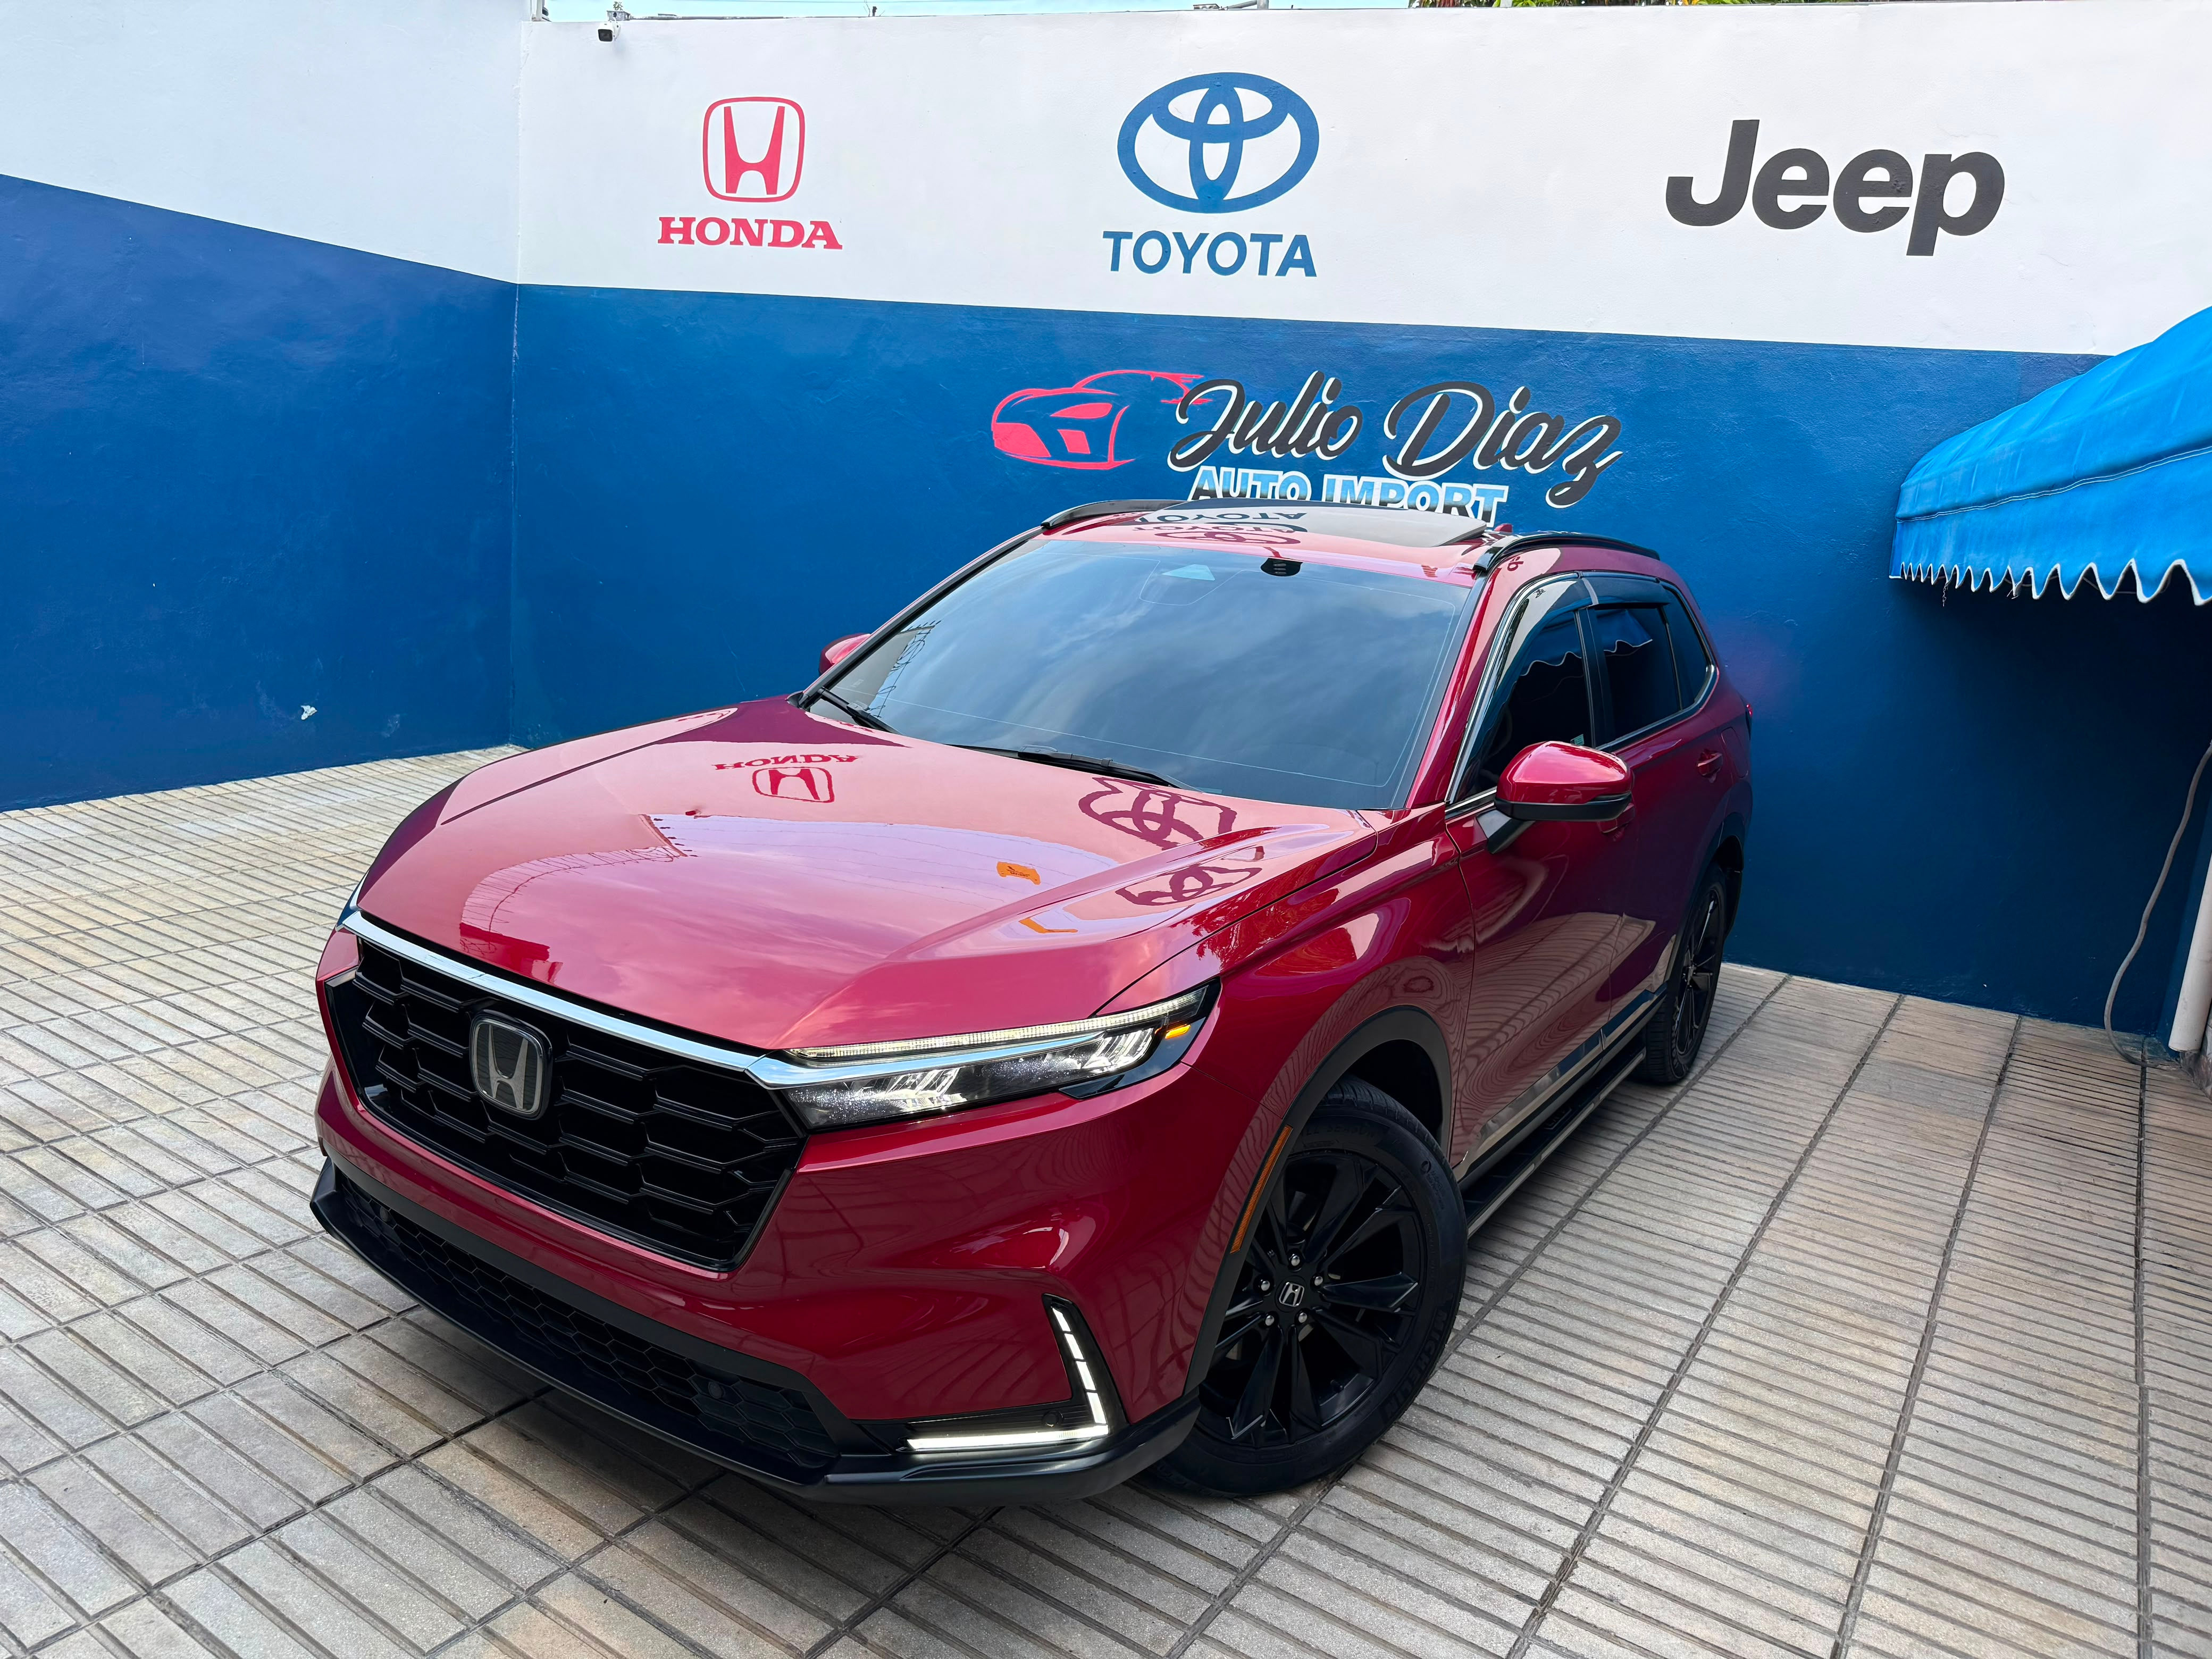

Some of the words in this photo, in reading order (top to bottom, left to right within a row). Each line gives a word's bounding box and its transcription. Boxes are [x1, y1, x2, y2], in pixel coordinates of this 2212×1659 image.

[1665, 119, 2005, 256] Jeep
[657, 216, 843, 250] HONDA
[1102, 230, 1318, 278] TOYOTA
[1167, 370, 1363, 472] Julio
[1382, 381, 1624, 509] Diaz
[1187, 466, 1312, 501] AUTO
[1321, 473, 1509, 527] IMPORT
